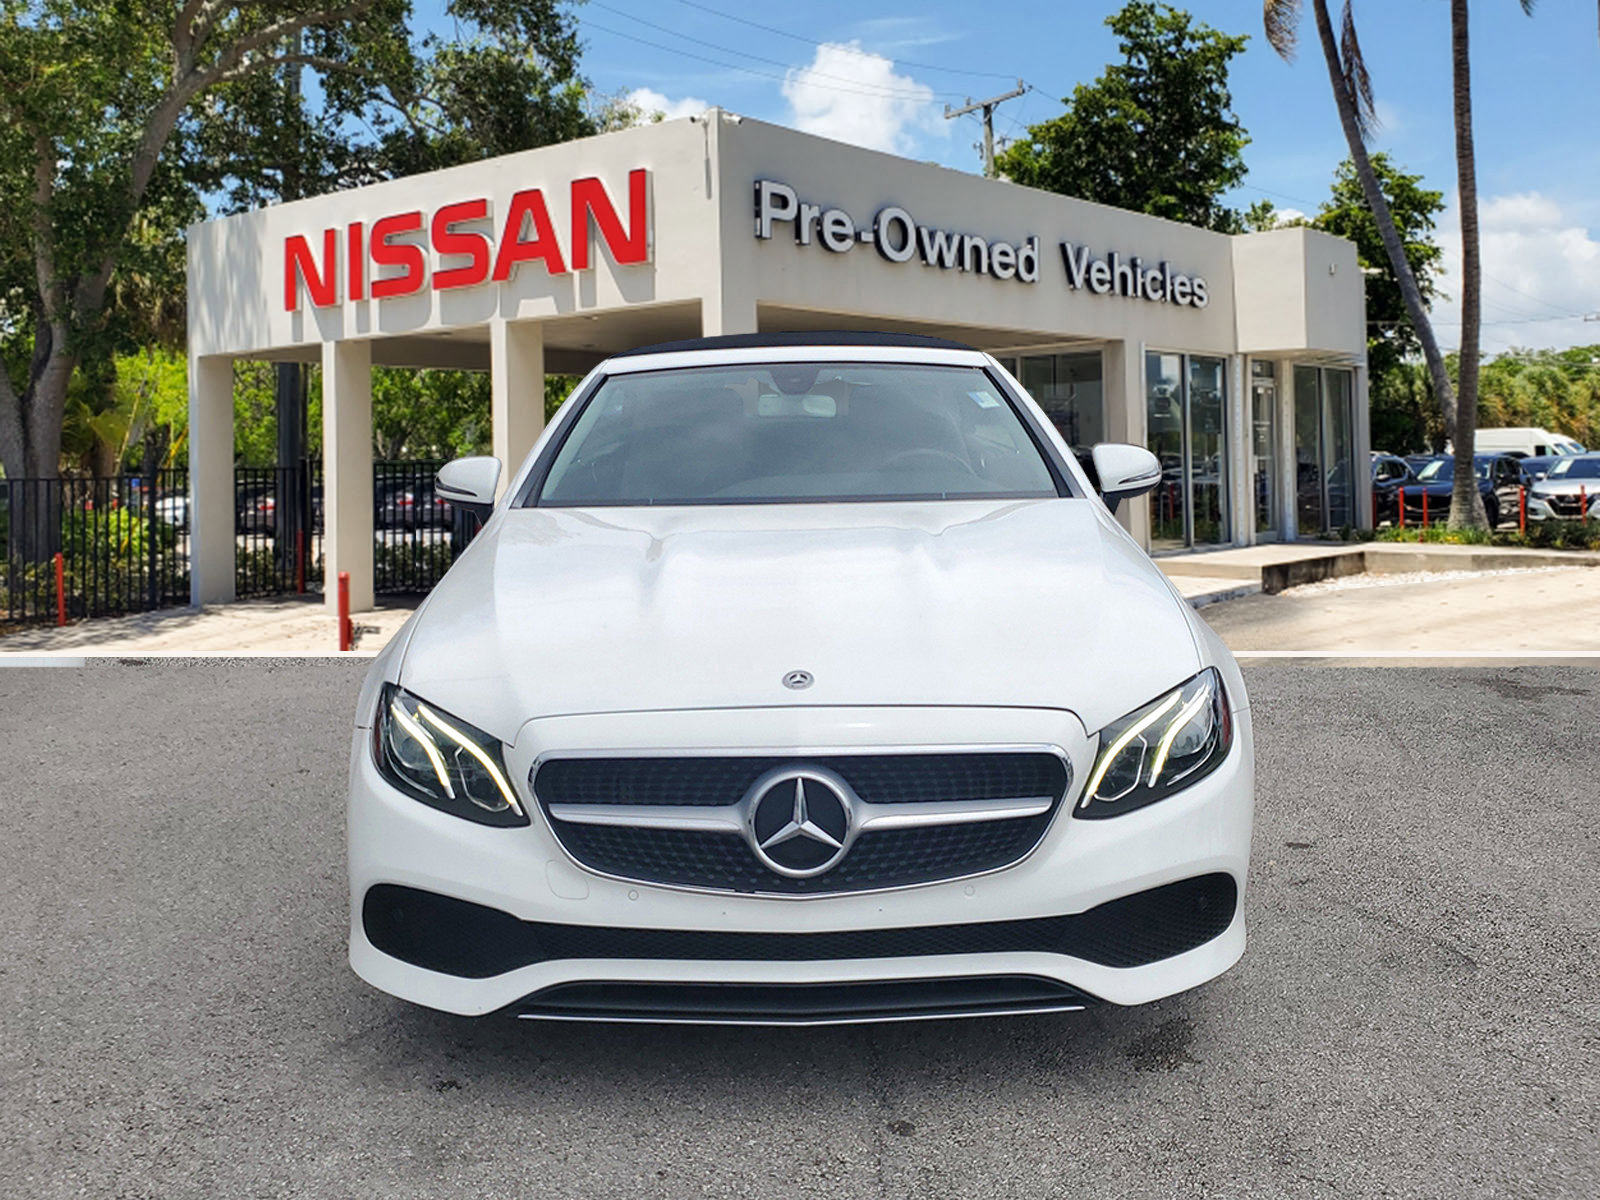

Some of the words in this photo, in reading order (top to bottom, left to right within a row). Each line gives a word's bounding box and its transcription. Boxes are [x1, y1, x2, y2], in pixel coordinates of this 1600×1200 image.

[284, 168, 649, 312] NISSAN
[755, 180, 1040, 284] Pre-Owned
[1061, 241, 1209, 308] Vehicles
